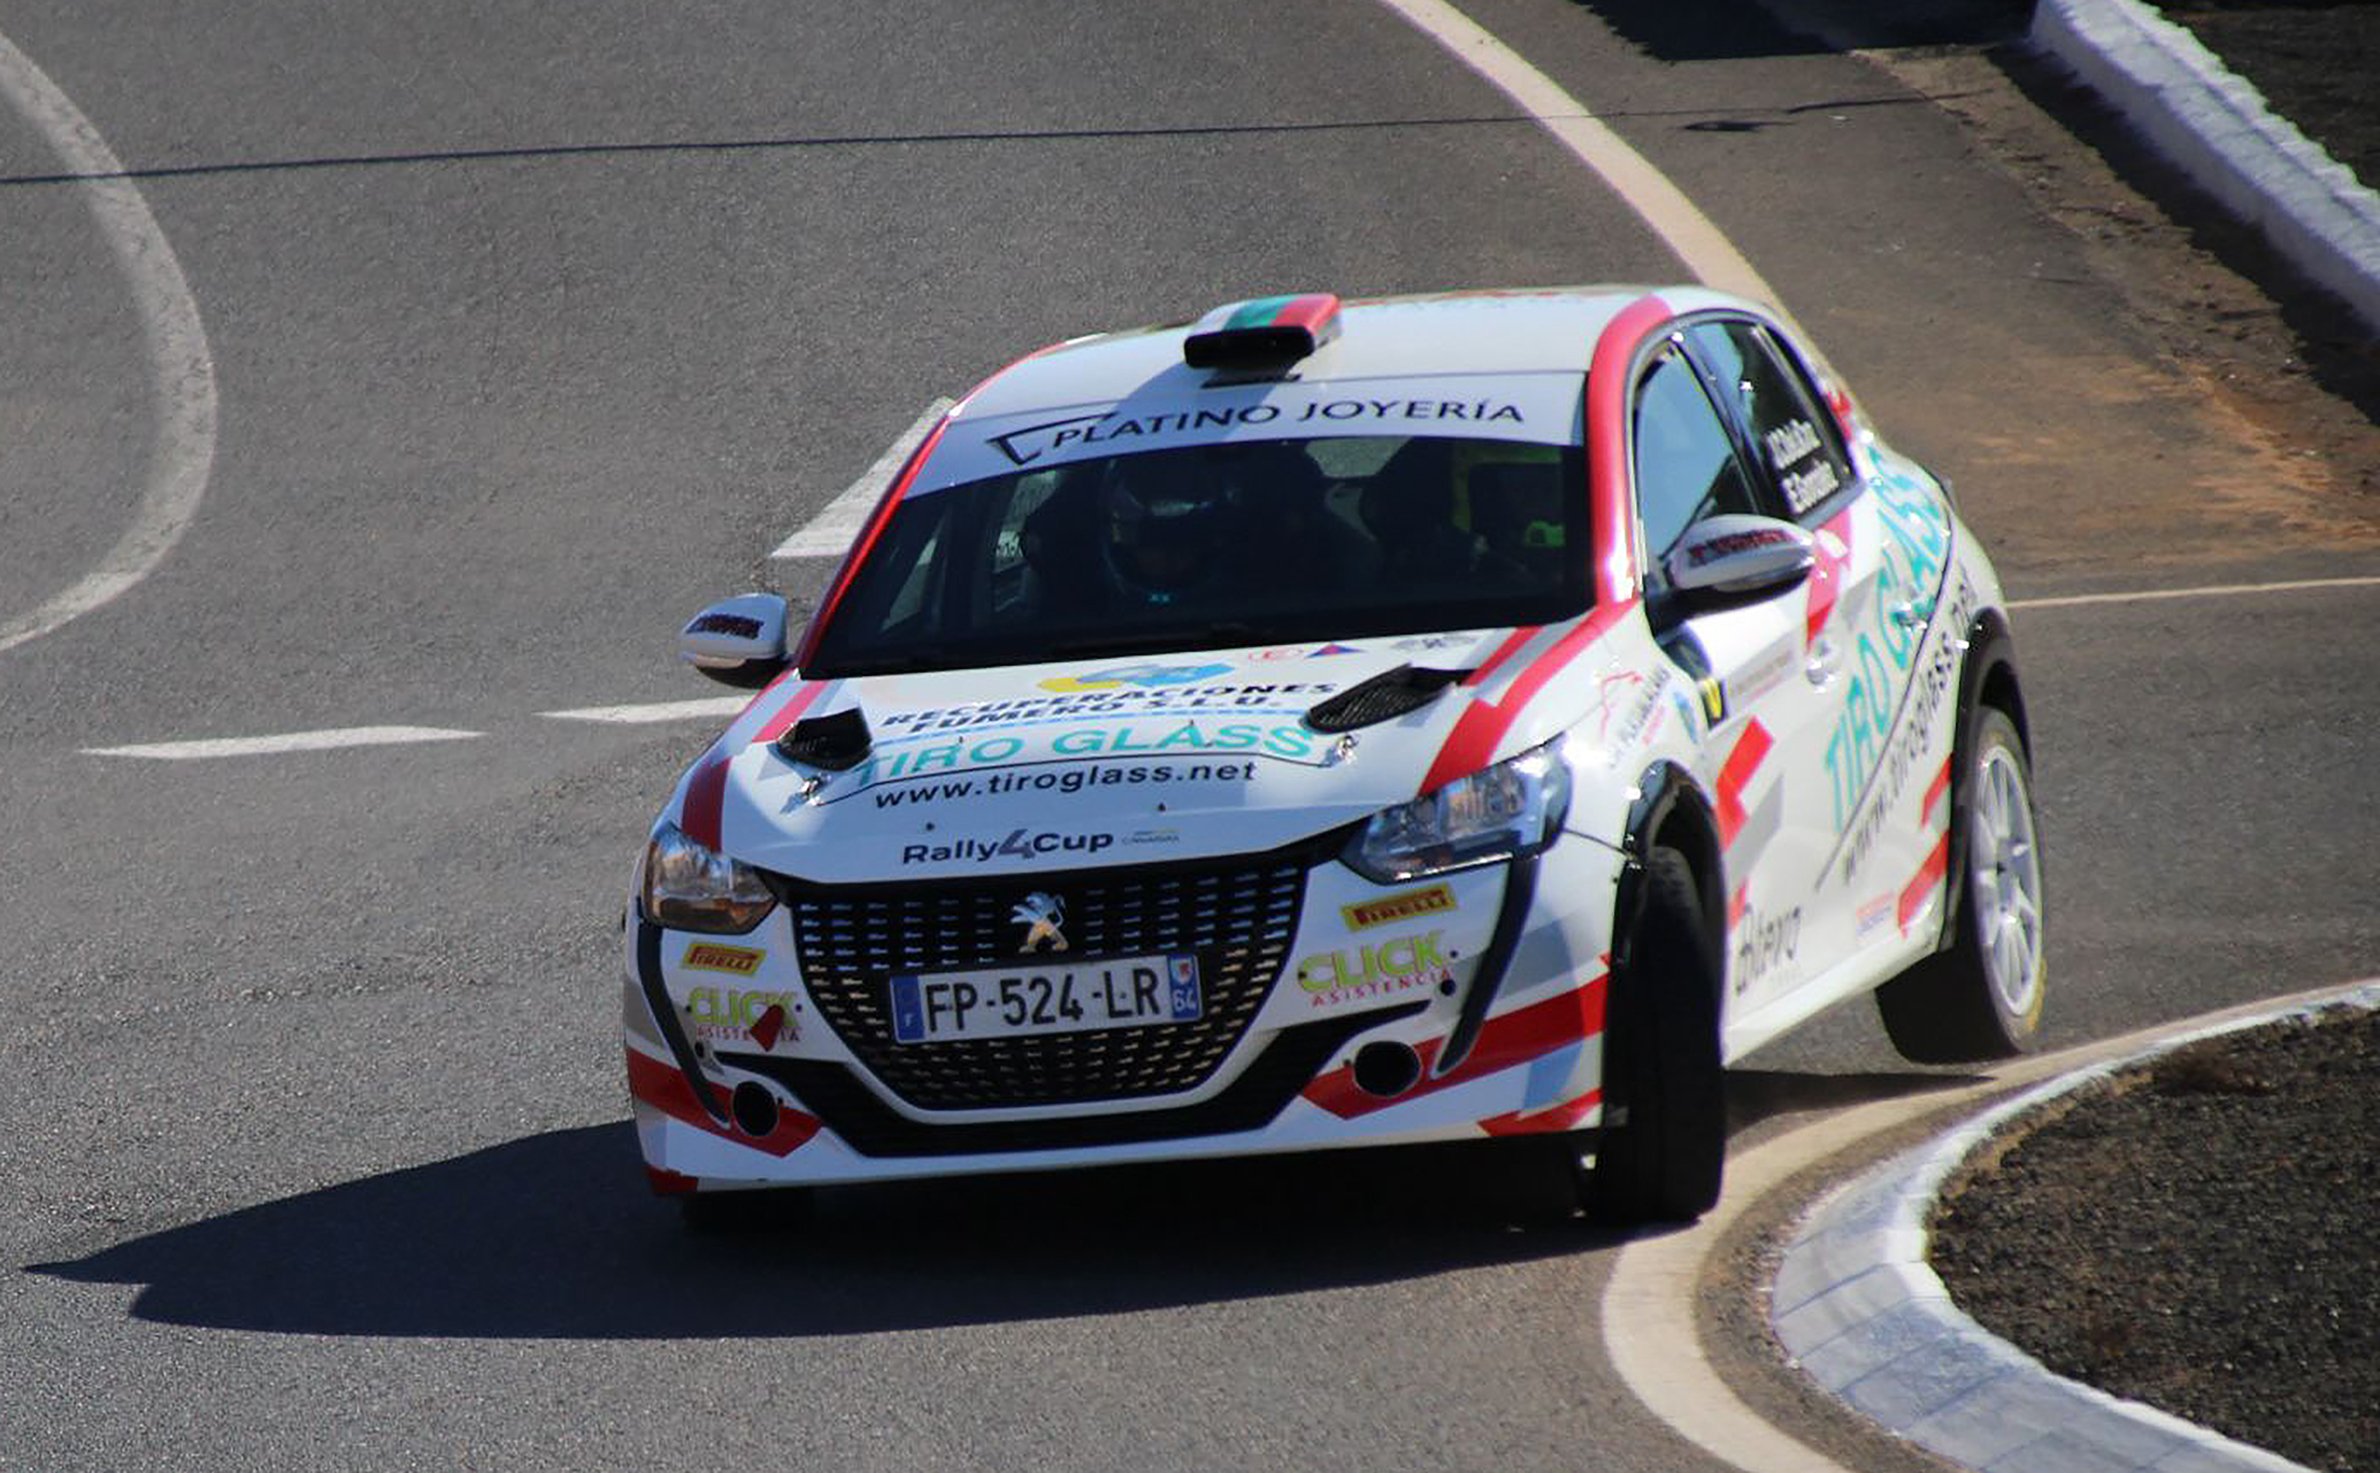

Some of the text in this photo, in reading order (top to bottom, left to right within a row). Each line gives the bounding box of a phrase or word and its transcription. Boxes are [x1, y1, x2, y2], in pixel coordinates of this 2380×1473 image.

[1052, 398, 1525, 449] PLATINO JOYERÍA
[882, 682, 1339, 726] RECUPERACIONES
[909, 701, 1123, 733] FUMERO
[852, 724, 1315, 787] TIRO GLASS
[875, 761, 1257, 809] www.tiroglass.net
[1352, 889, 1450, 926] PIRELLI
[689, 946, 759, 974] PIRELLI
[1298, 930, 1444, 992] CLICK
[924, 967, 1161, 1033] FP-524-LR
[1172, 988, 1198, 1013] 64
[1311, 966, 1451, 1008] ASISTENCIA
[696, 1024, 800, 1042] ASISTEIA
